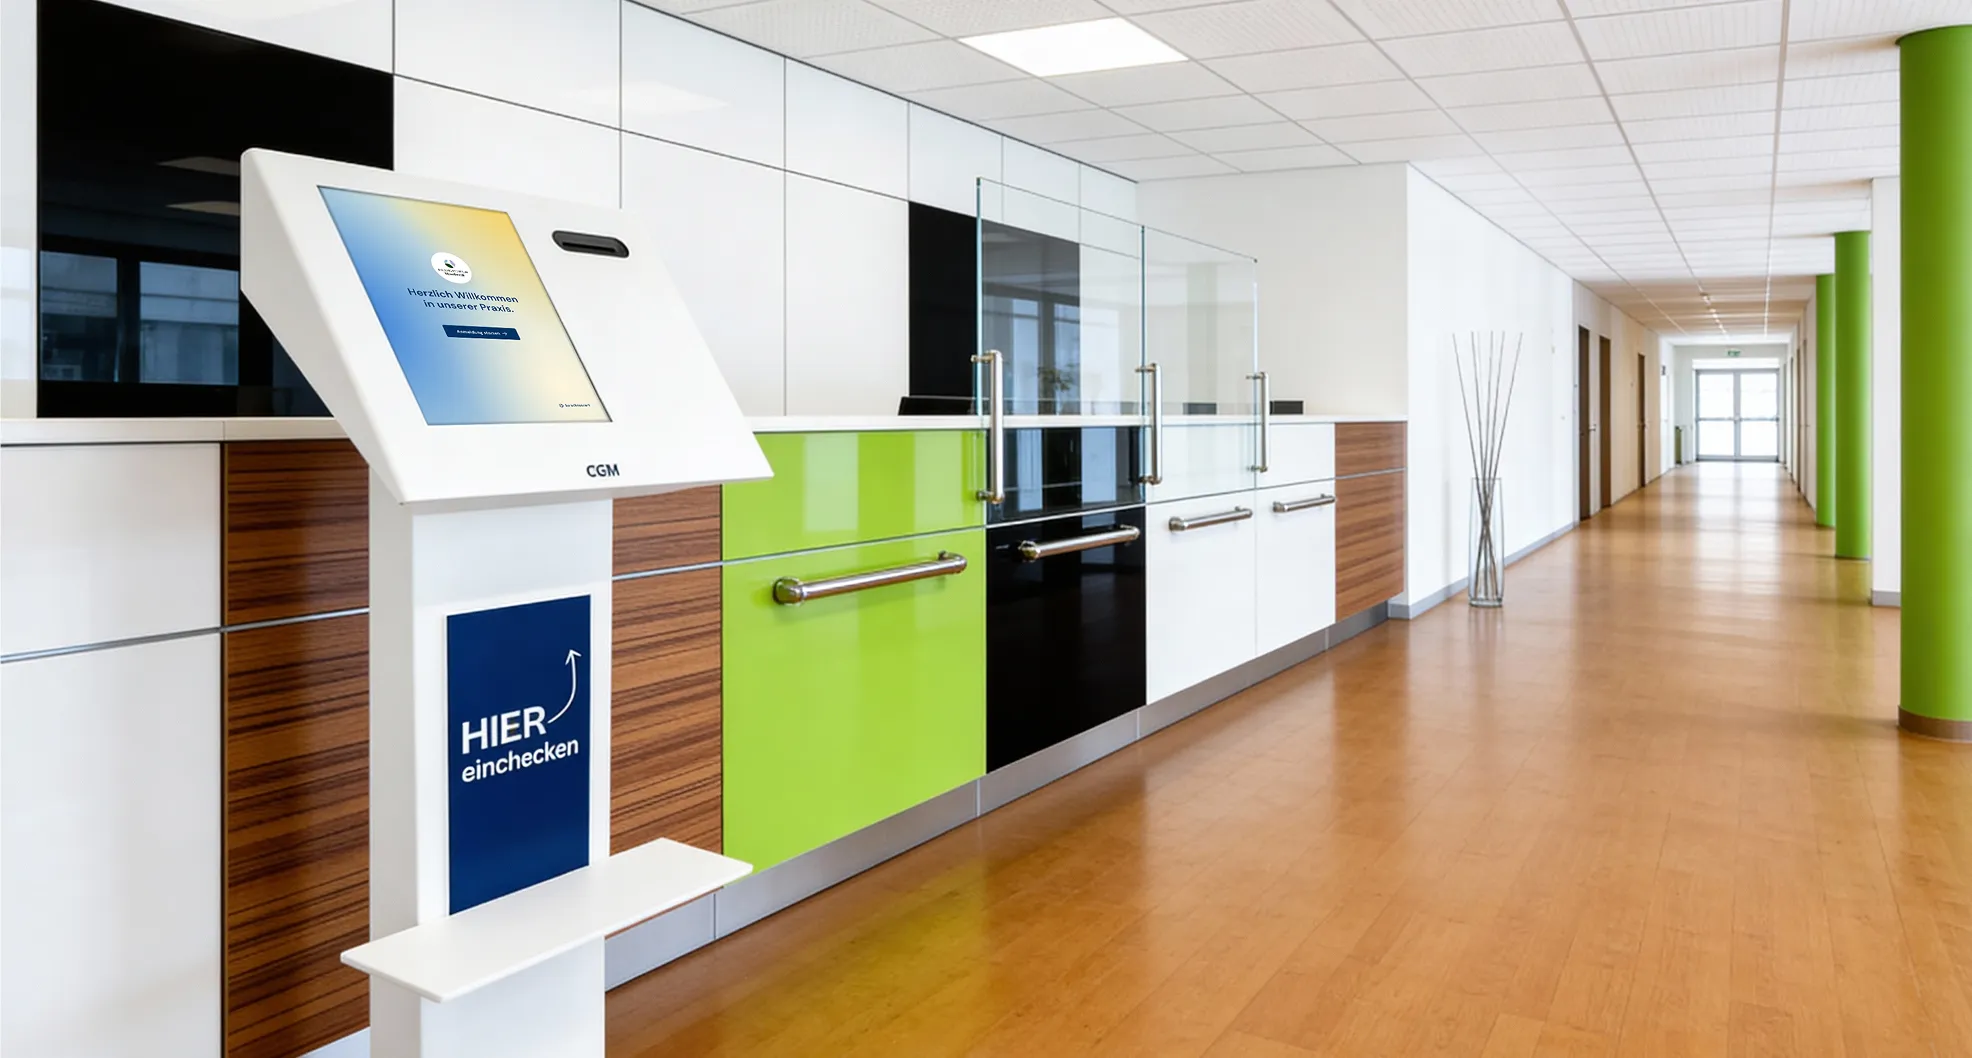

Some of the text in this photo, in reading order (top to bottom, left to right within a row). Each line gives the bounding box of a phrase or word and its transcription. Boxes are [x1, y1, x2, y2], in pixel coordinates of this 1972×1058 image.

[407, 288, 519, 303] Herzlich Willkommen
[423, 300, 515, 313] in unserer Praxis.
[586, 463, 620, 478] CGM
[462, 706, 546, 755] HIER
[462, 739, 579, 782] einchecken
